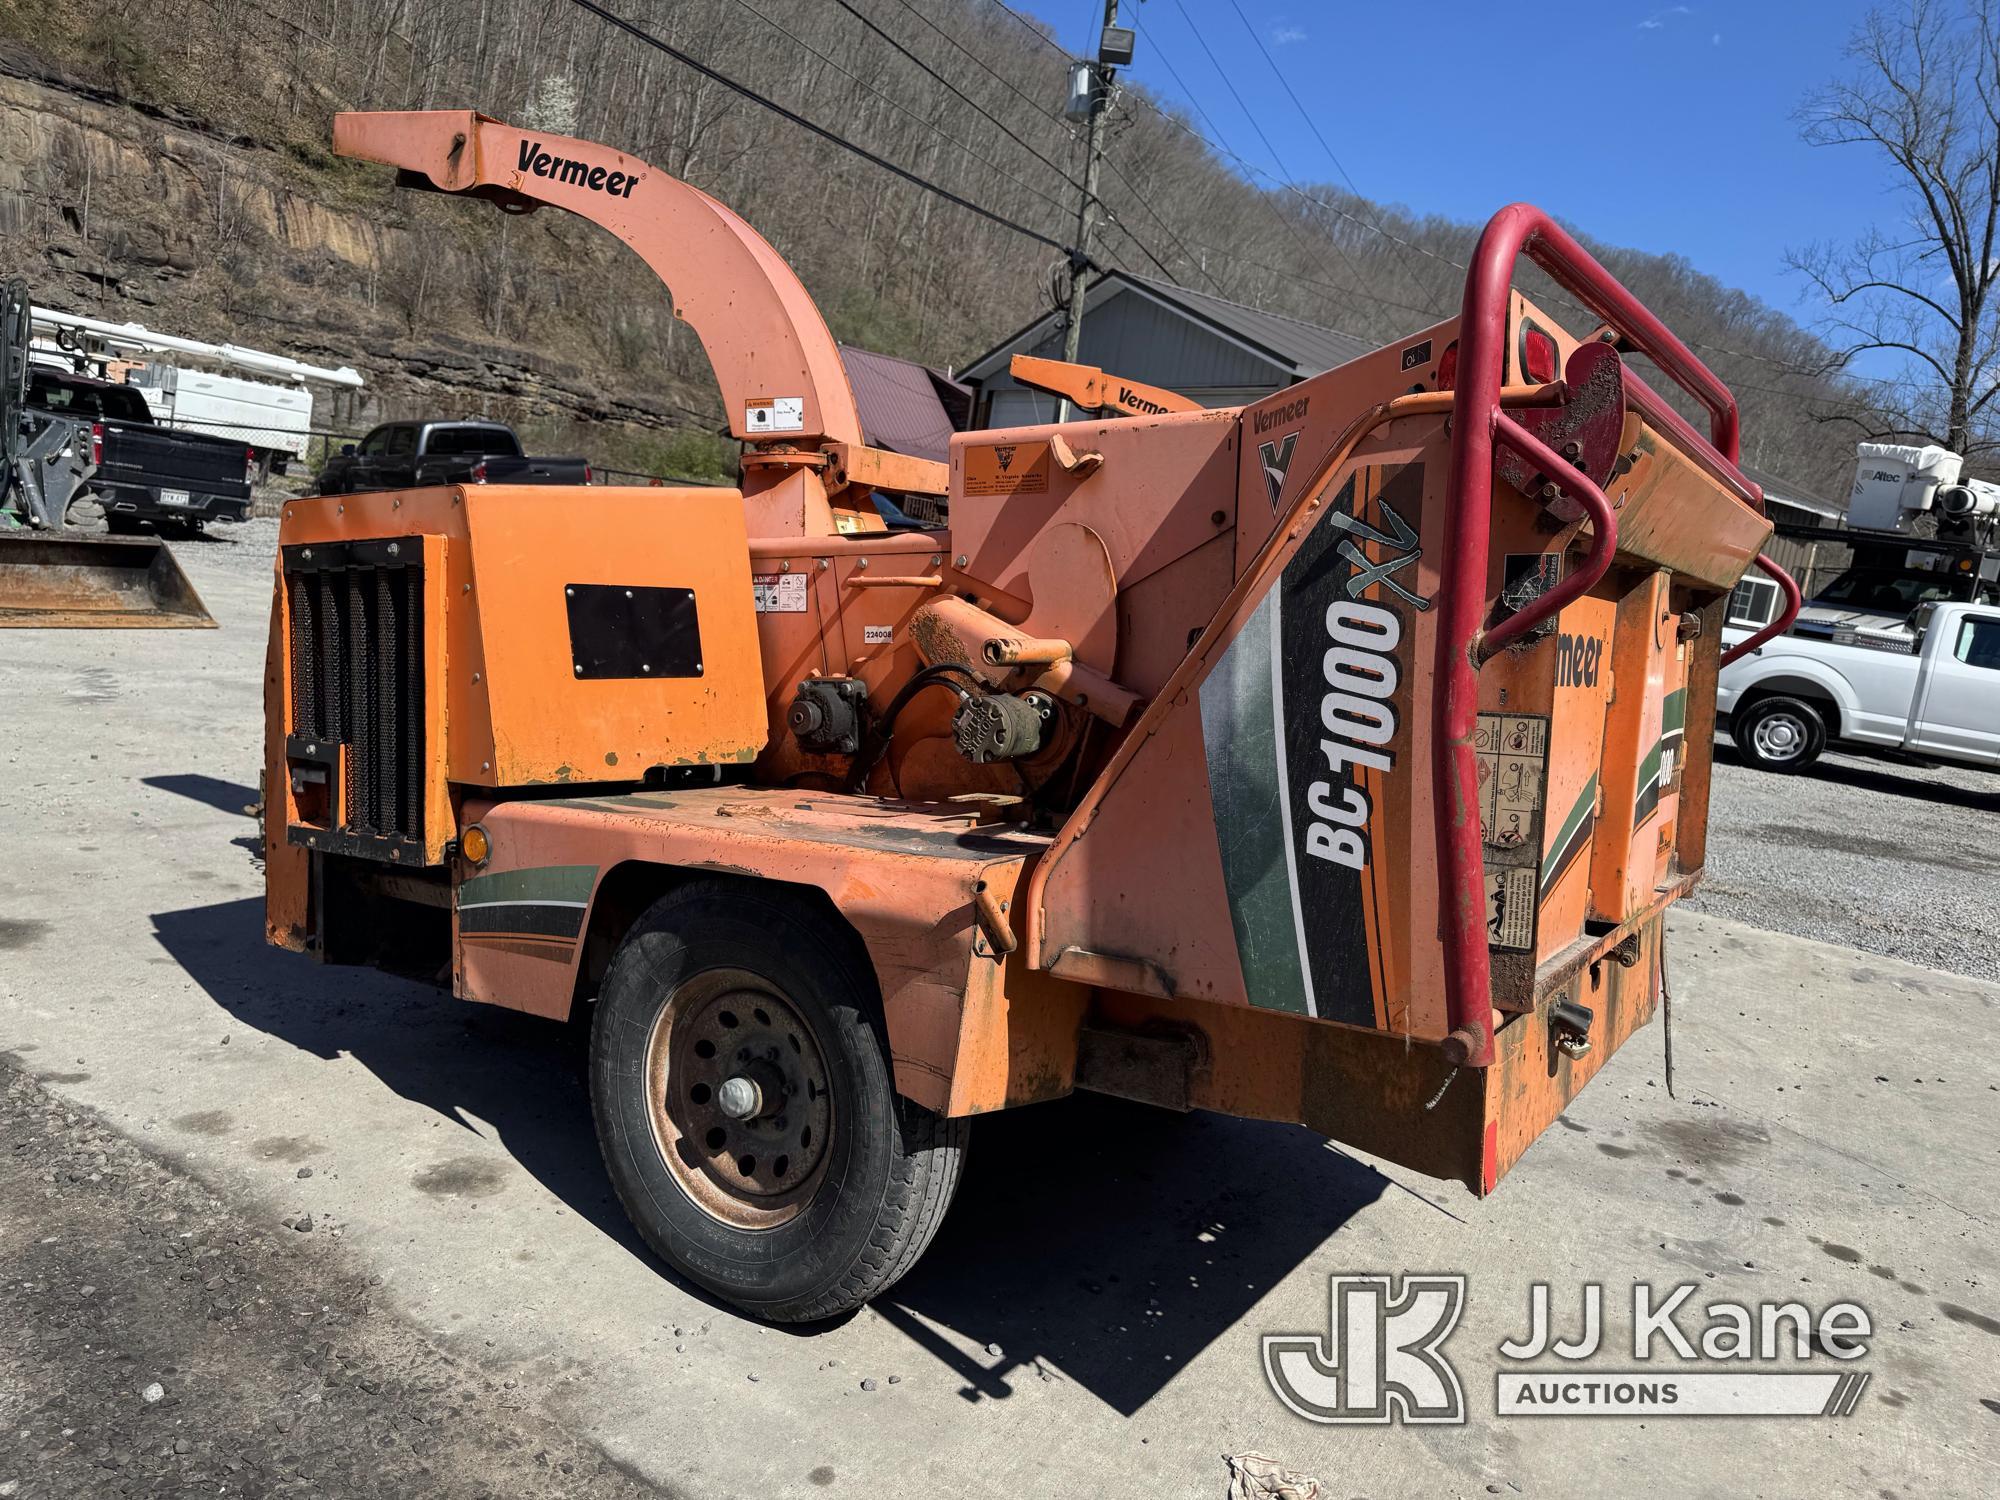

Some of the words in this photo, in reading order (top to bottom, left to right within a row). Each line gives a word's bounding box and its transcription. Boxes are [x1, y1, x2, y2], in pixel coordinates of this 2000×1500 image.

[518, 139, 639, 199] Vermeer
[1118, 386, 1177, 415] Verme
[1253, 396, 1310, 435] Vermeer
[1872, 471, 1901, 482] Altec
[866, 631, 892, 639] 224008
[1555, 633, 1602, 688] meer
